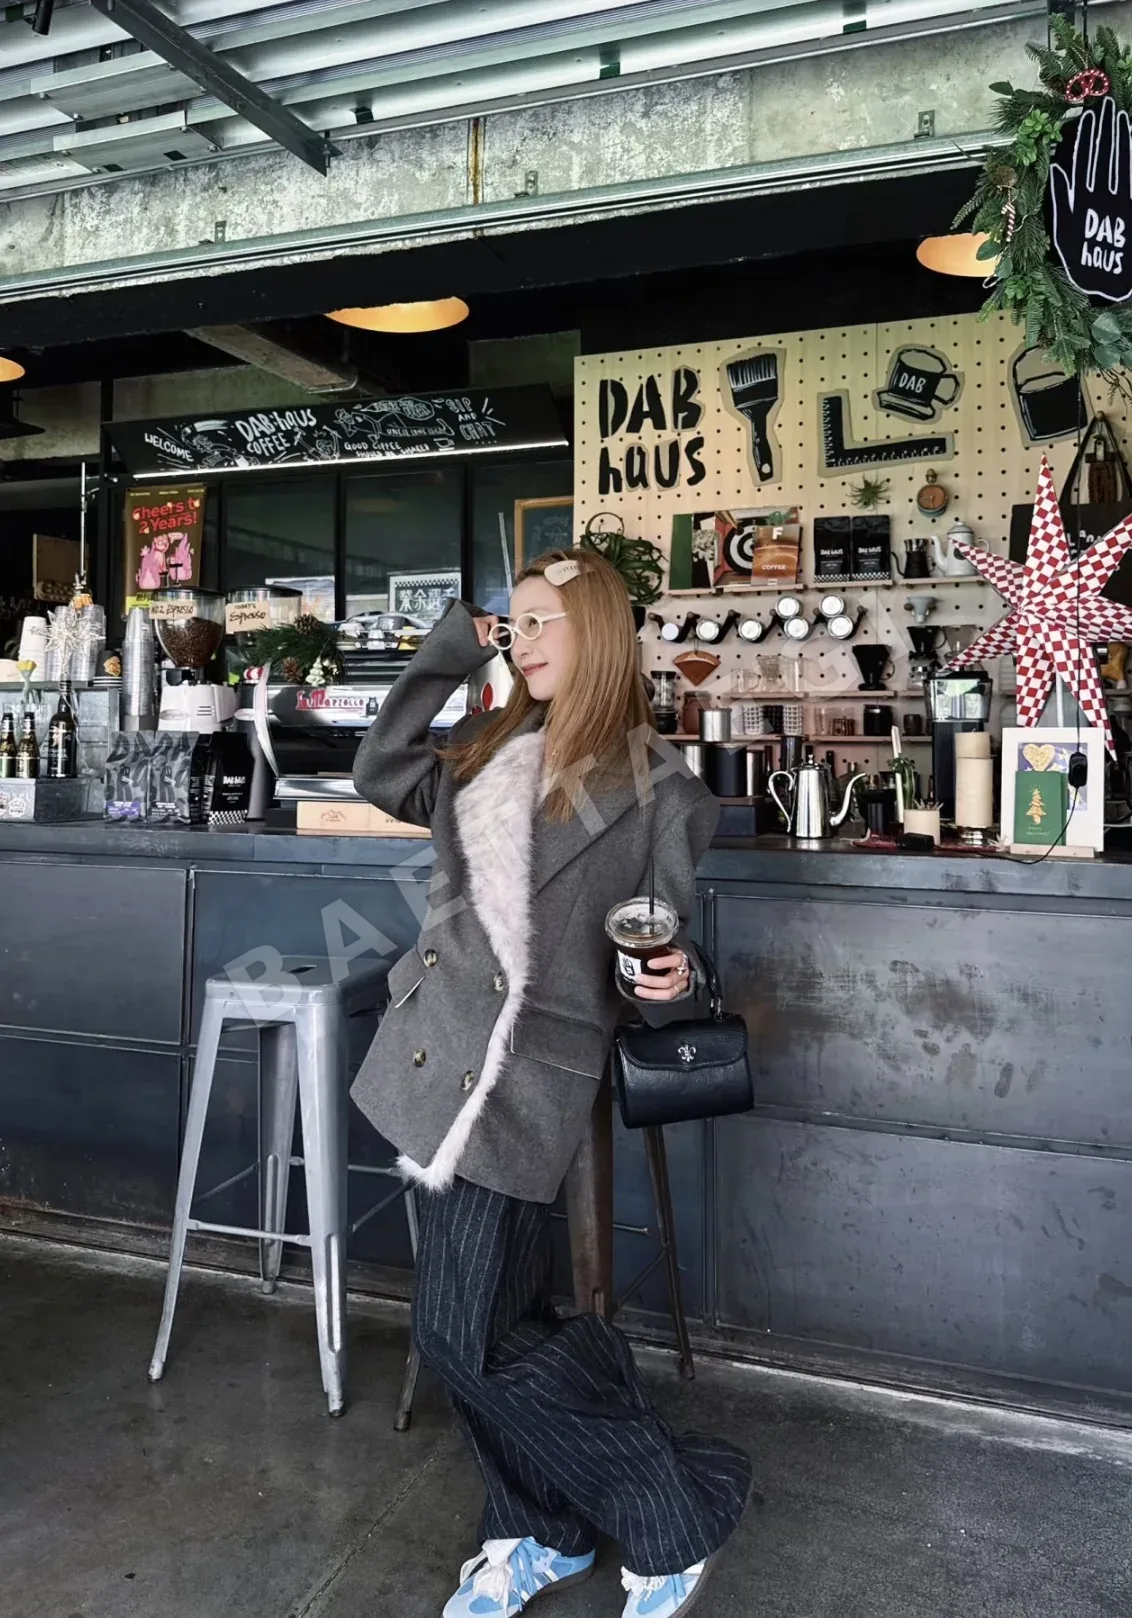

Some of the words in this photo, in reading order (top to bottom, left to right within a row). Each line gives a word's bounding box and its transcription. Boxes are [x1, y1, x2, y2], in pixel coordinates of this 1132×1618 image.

[1084, 208, 1125, 248] DAB
[1080, 241, 1124, 274] haus
[898, 372, 926, 393] DAB
[598, 366, 701, 438] DAB
[459, 421, 496, 440] CHAT
[144, 432, 194, 462] WELCOME
[246, 432, 290, 456] COFFEE
[344, 441, 368, 451] GOOD
[598, 436, 706, 495] haus
[150, 510, 198, 532] Years!
[772, 526, 784, 540] F
